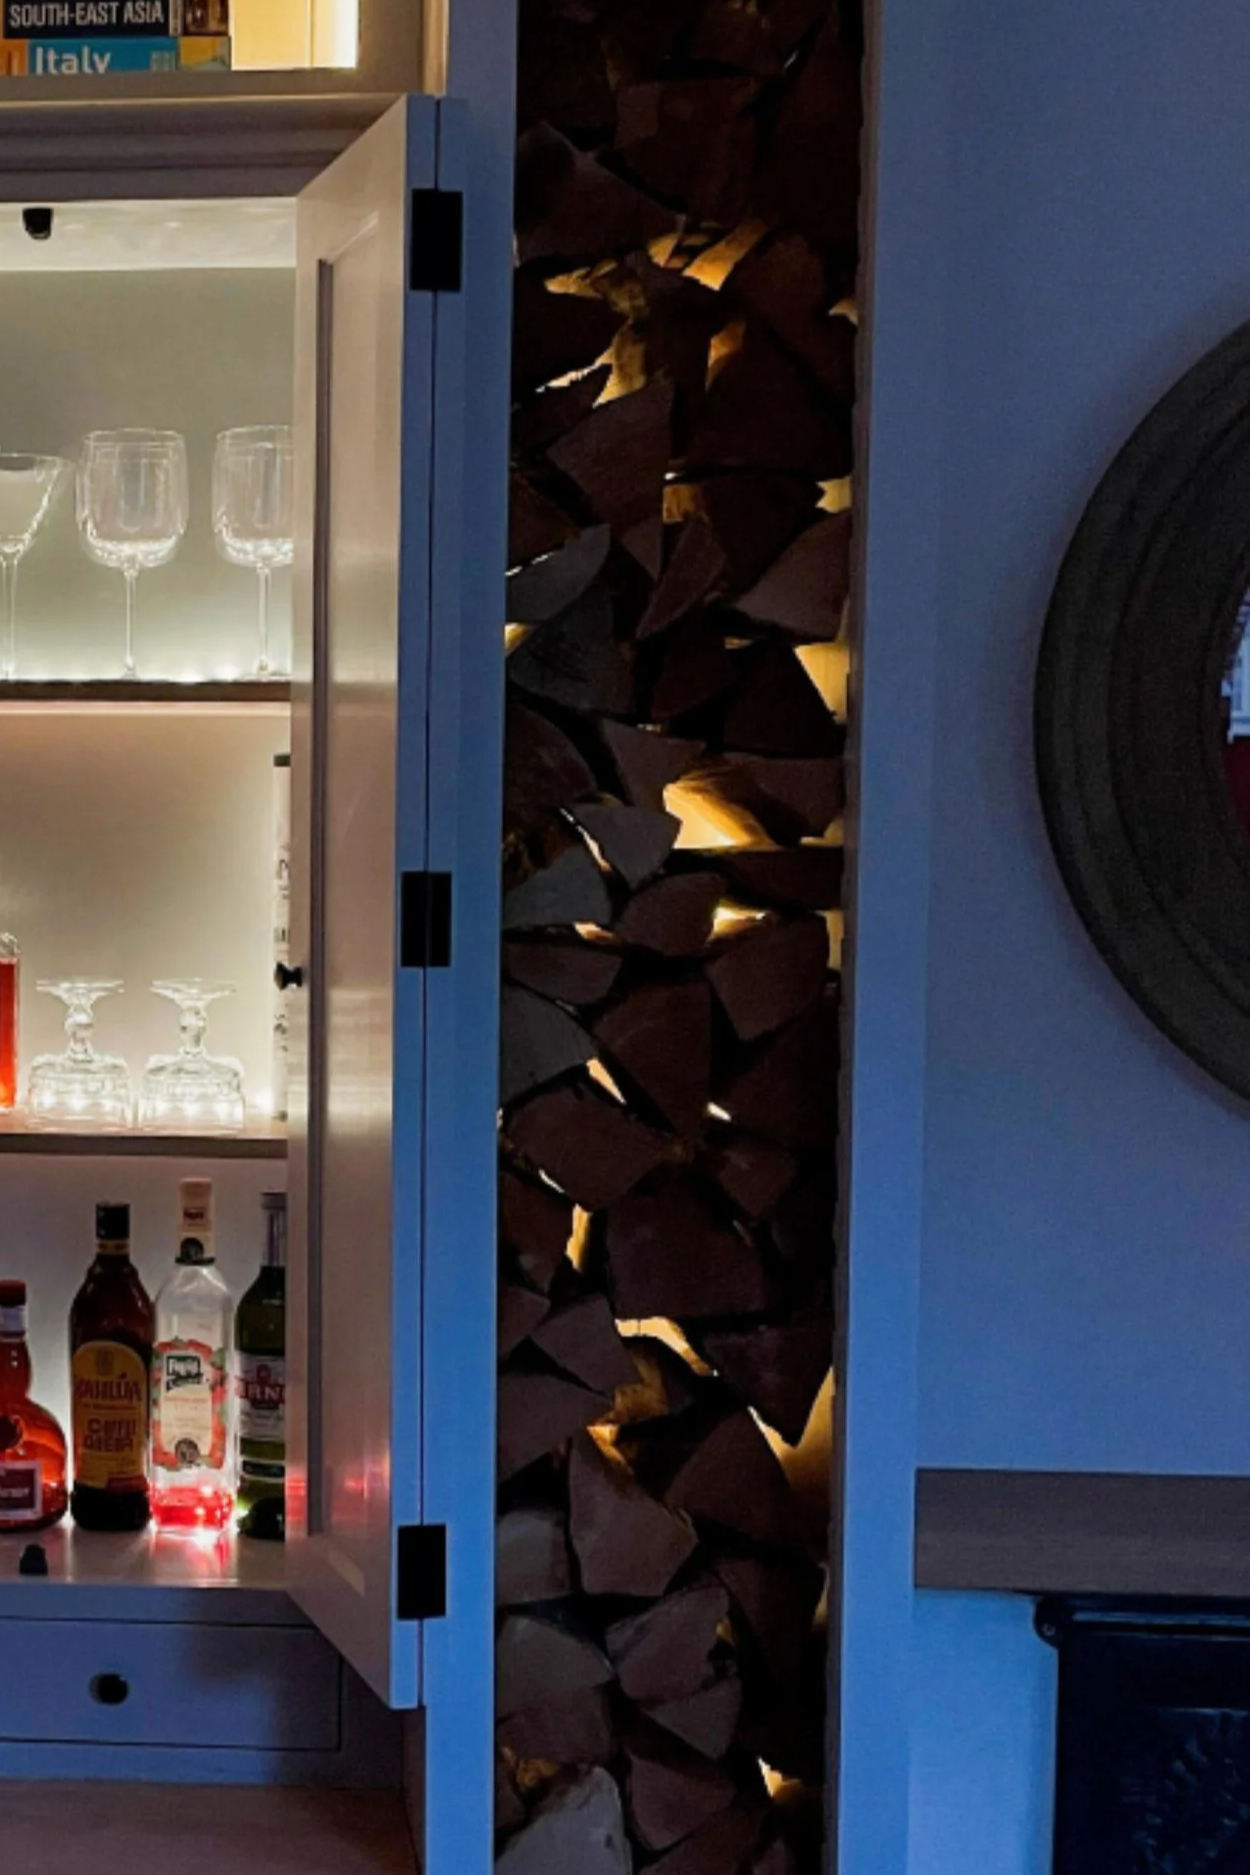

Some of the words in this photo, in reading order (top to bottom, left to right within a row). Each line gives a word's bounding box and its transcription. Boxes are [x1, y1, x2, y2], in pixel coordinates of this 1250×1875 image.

[9, 2, 118, 27] SOUTH-EAST
[123, 0, 164, 23] ASIA
[36, 46, 111, 75] Italy
